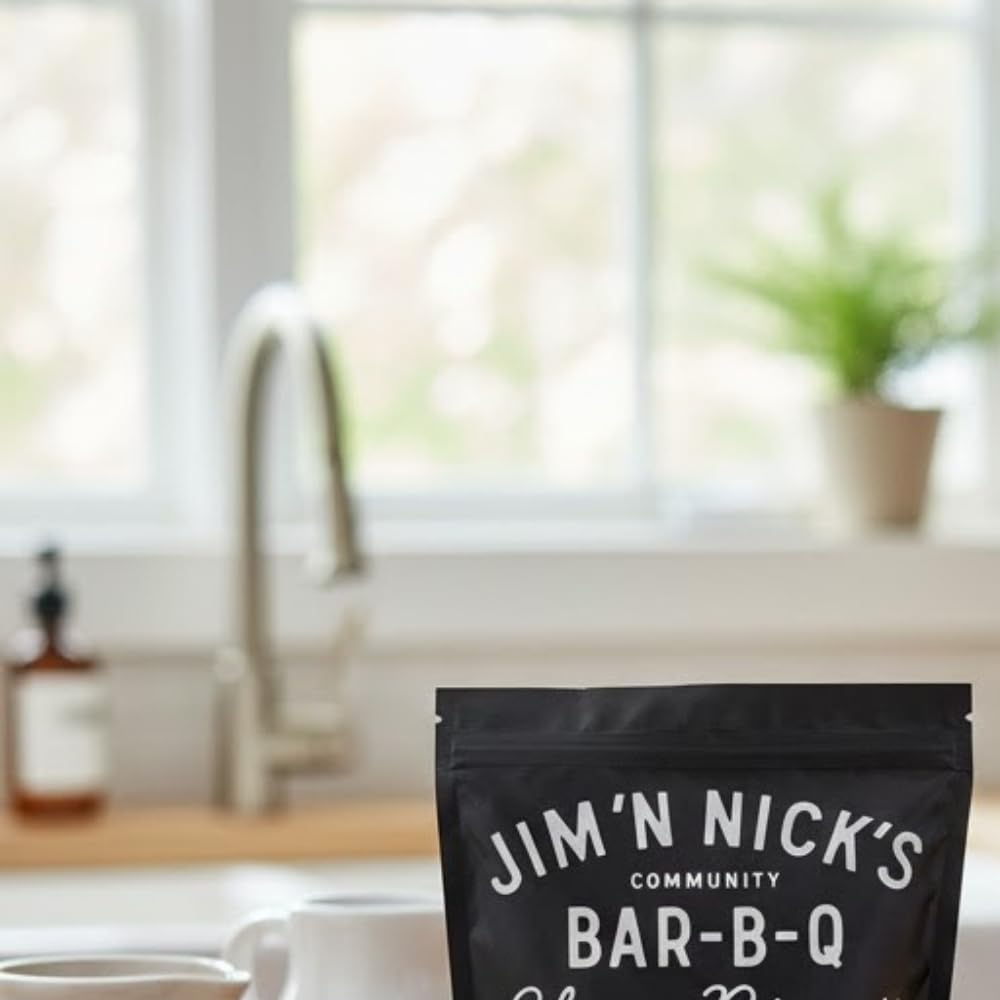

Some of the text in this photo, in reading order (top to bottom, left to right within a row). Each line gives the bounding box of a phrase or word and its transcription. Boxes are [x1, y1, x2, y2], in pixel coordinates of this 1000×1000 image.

[704, 790, 922, 889] NICK'S
[631, 872, 780, 889] COMMUNITY
[568, 904, 843, 968] BAR-B-Q
